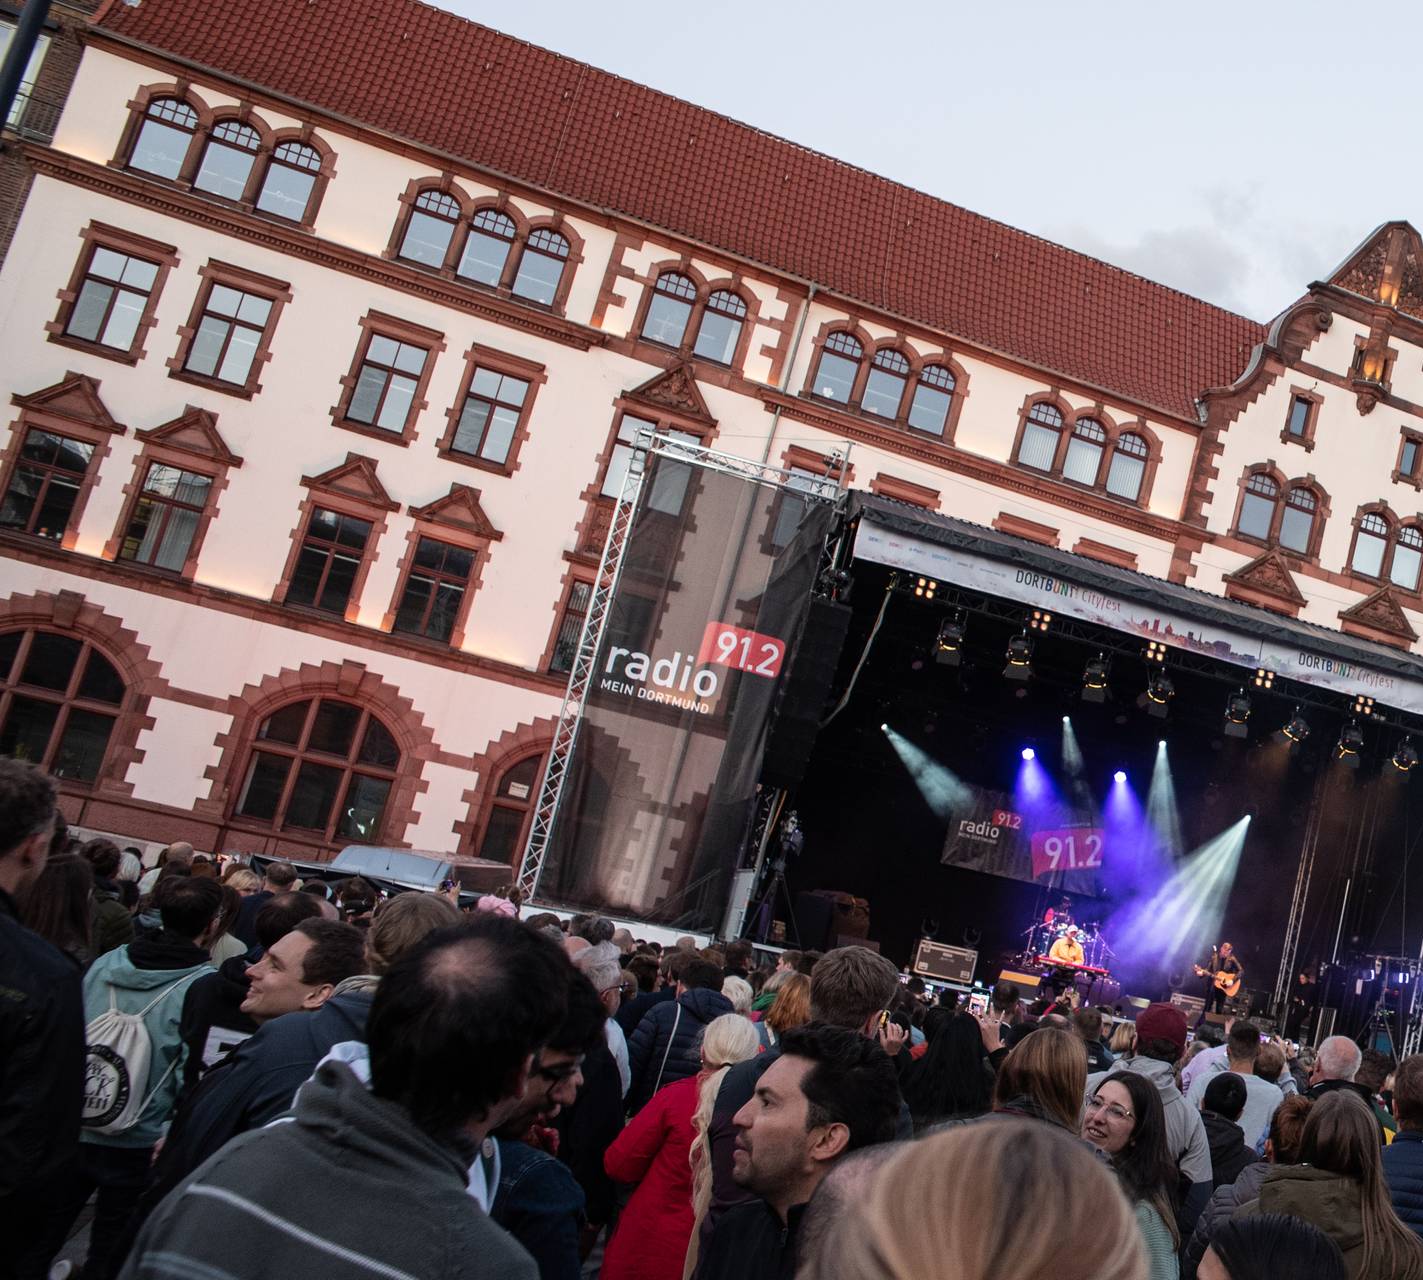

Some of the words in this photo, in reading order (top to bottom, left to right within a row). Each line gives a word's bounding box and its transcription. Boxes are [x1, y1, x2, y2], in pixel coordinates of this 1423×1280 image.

[604, 645, 718, 698] radio
[716, 630, 780, 677] 91.2
[600, 677, 634, 697] MEIN
[637, 686, 709, 714] DORTMUND
[959, 819, 1000, 839] radio
[998, 812, 1022, 830] 91.2
[1045, 834, 1102, 869] 91.2
